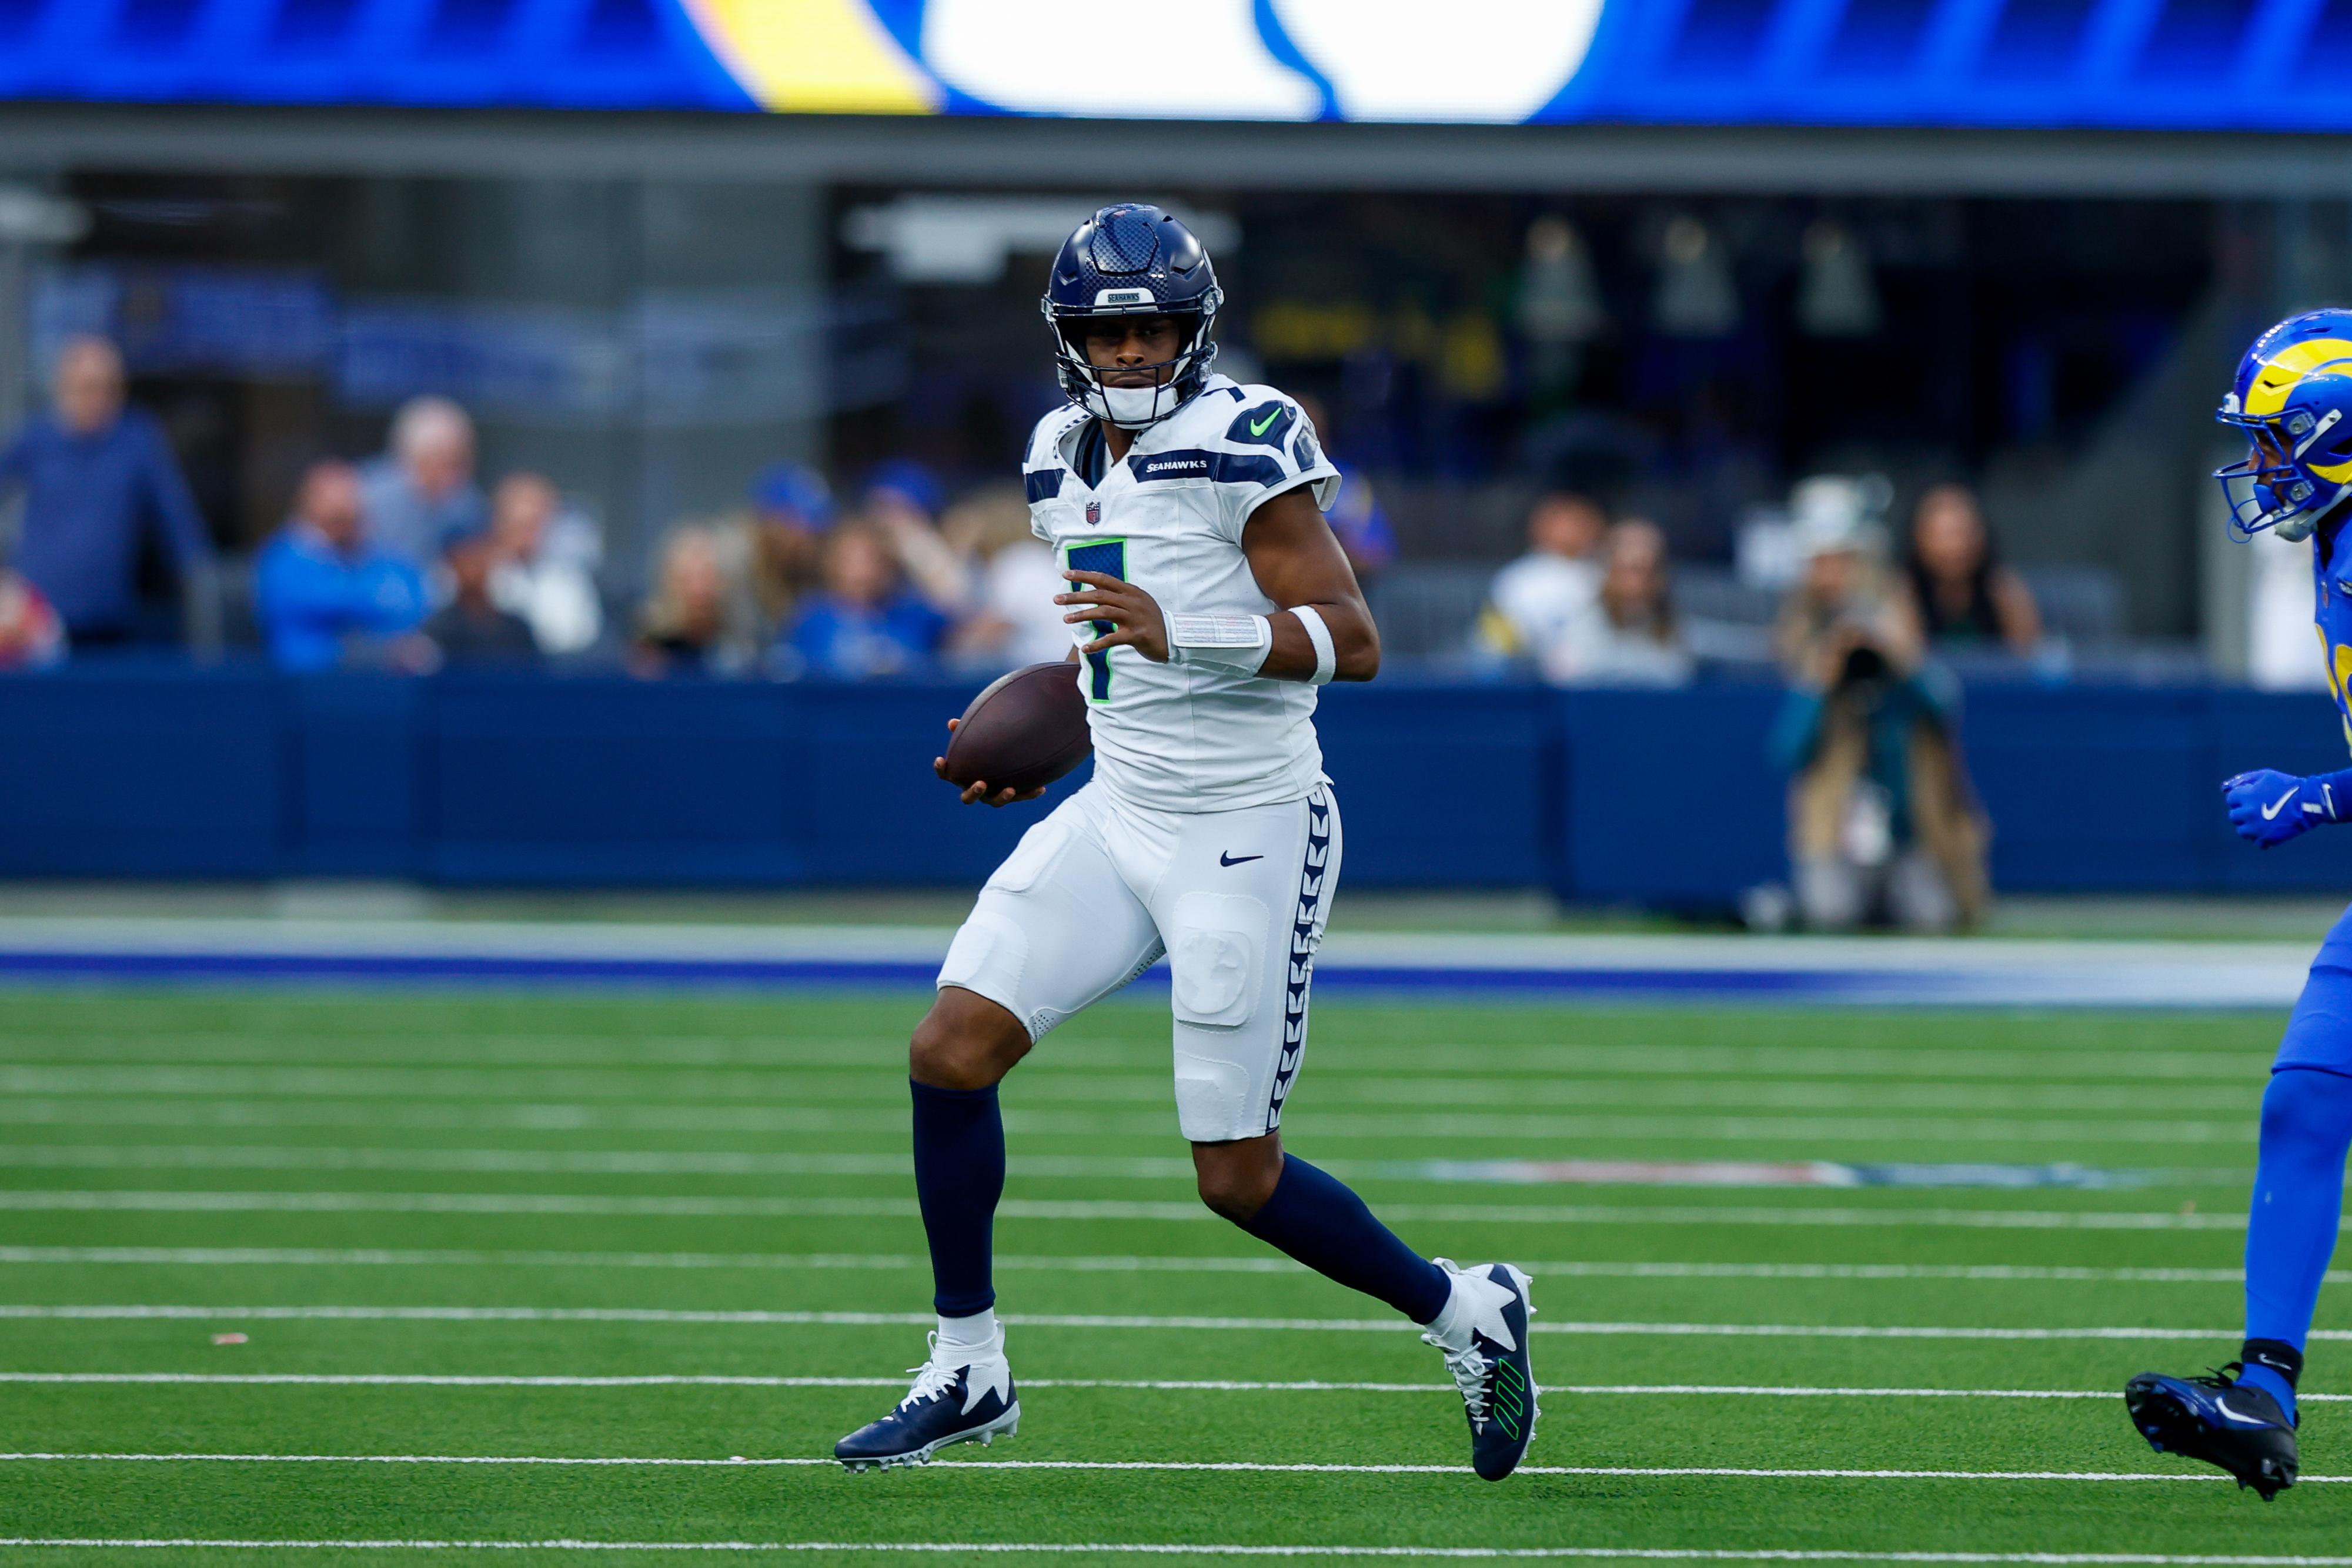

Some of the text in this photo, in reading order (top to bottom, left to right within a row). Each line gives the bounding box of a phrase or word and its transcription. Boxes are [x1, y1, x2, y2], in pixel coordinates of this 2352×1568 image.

[1108, 293, 1140, 302] SEAHAWKS
[1146, 460, 1207, 473] SEAHAWKS
[1065, 536, 1128, 703] 7
